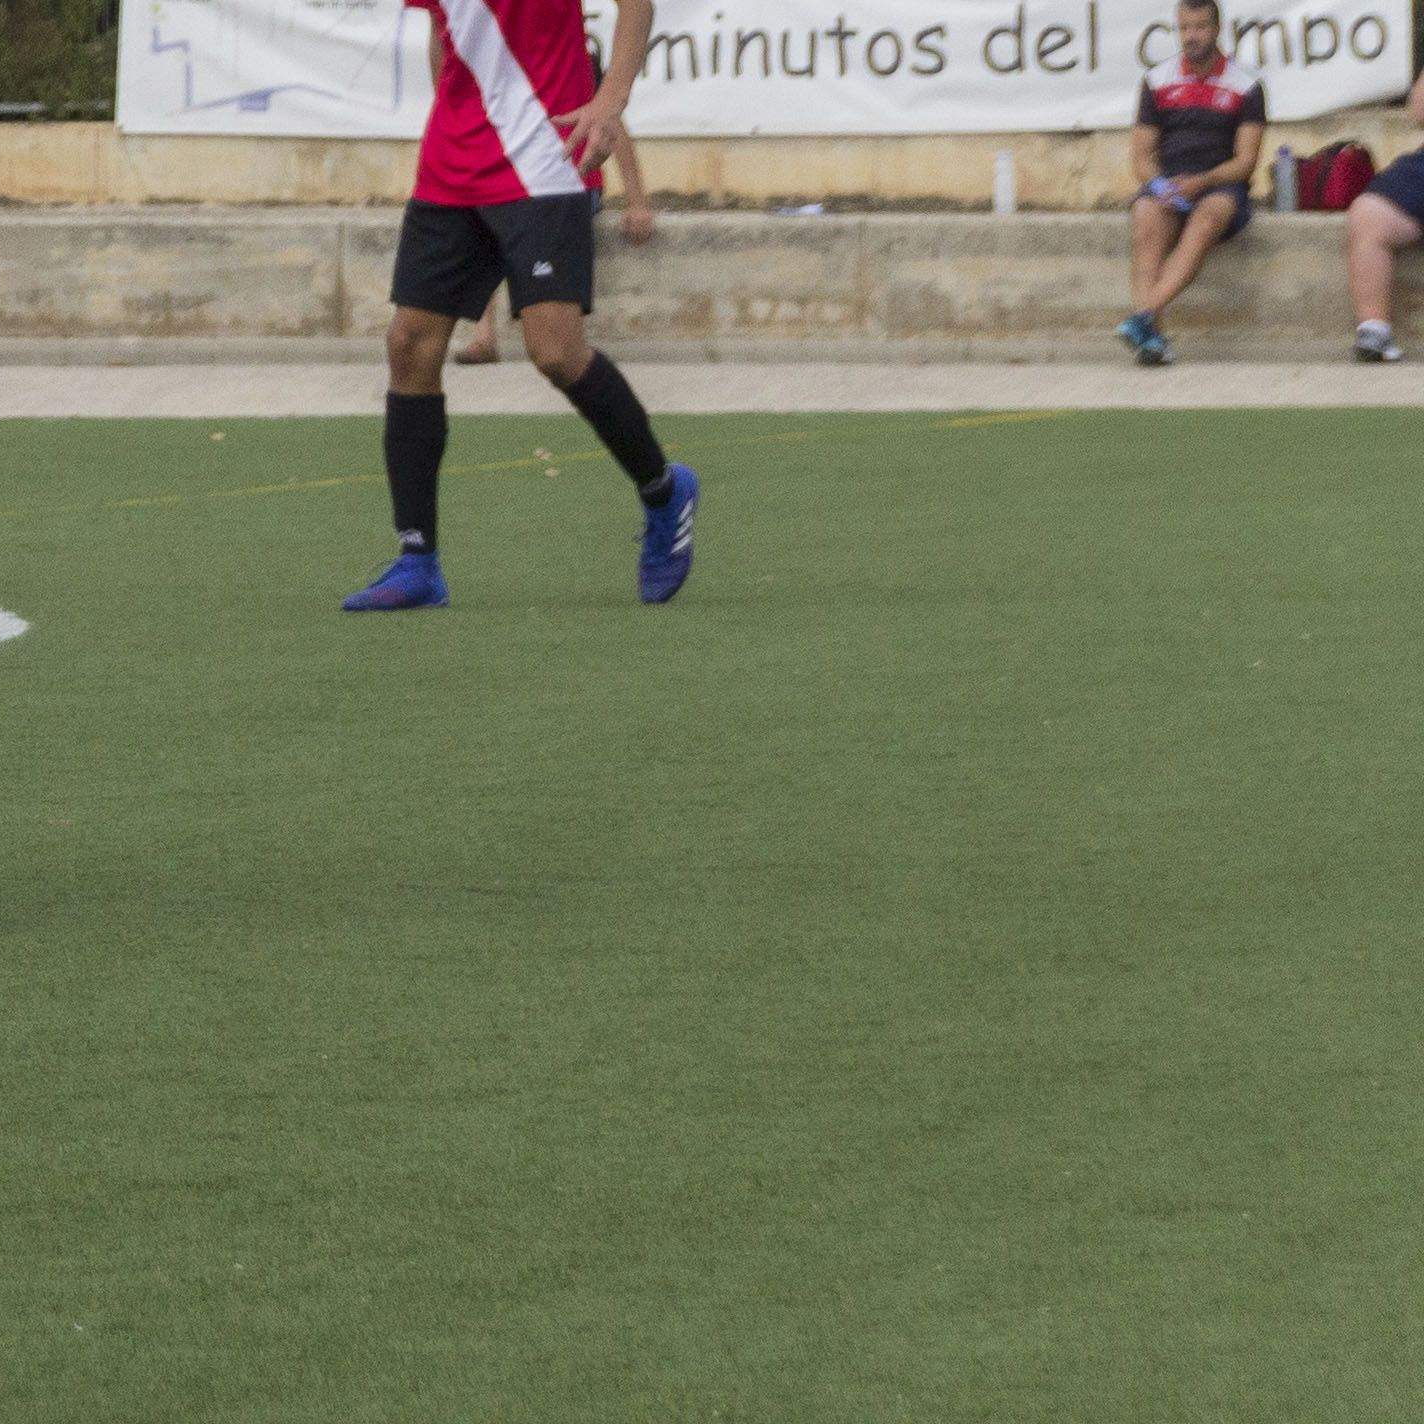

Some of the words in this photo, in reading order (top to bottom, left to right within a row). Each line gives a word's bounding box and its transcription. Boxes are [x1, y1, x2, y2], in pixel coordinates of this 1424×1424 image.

[641, 12, 949, 84] minutos
[982, 0, 1099, 76] del
[1136, 12, 1388, 71] cmpo
